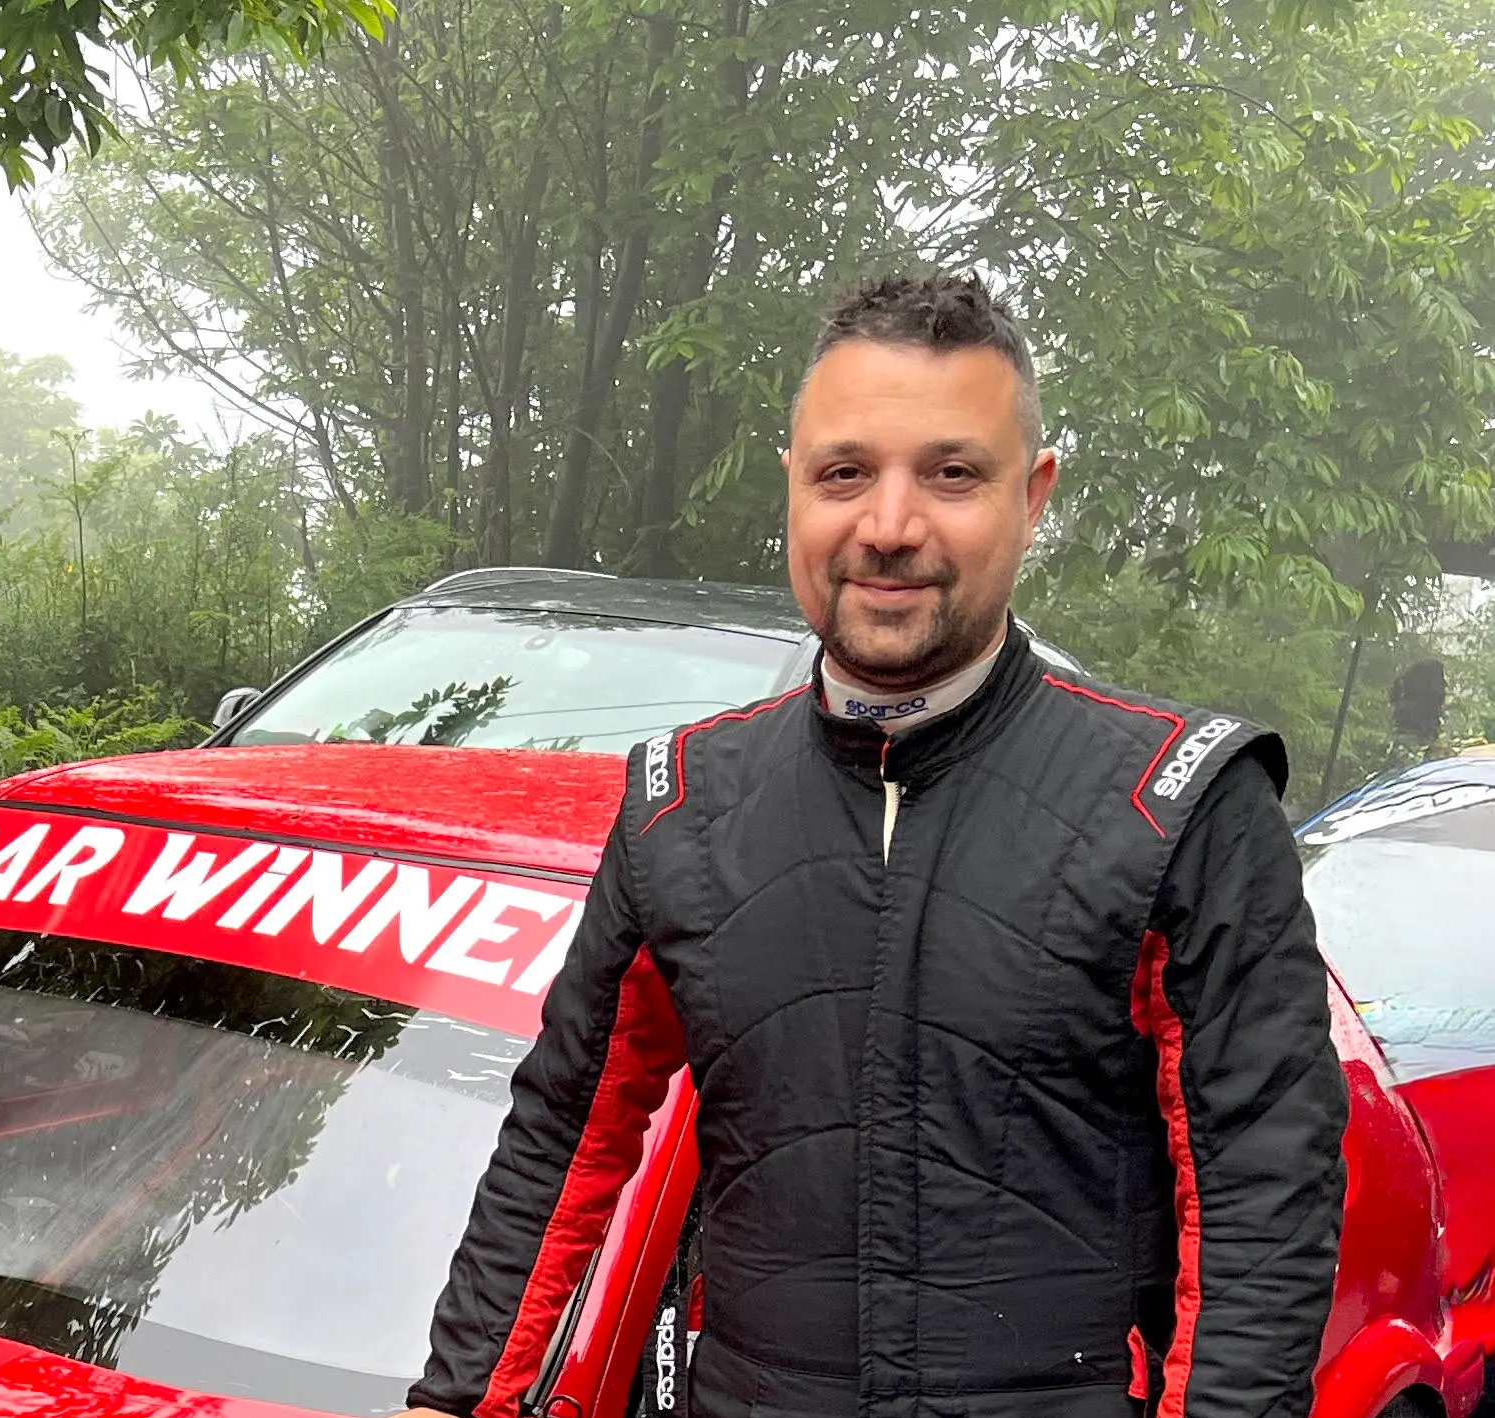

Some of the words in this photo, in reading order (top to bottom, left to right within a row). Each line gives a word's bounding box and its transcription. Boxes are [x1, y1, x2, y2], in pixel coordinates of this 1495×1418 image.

[845, 697, 927, 717] sparco
[1153, 718, 1234, 797] sparco
[656, 1306, 676, 1411] sparco
